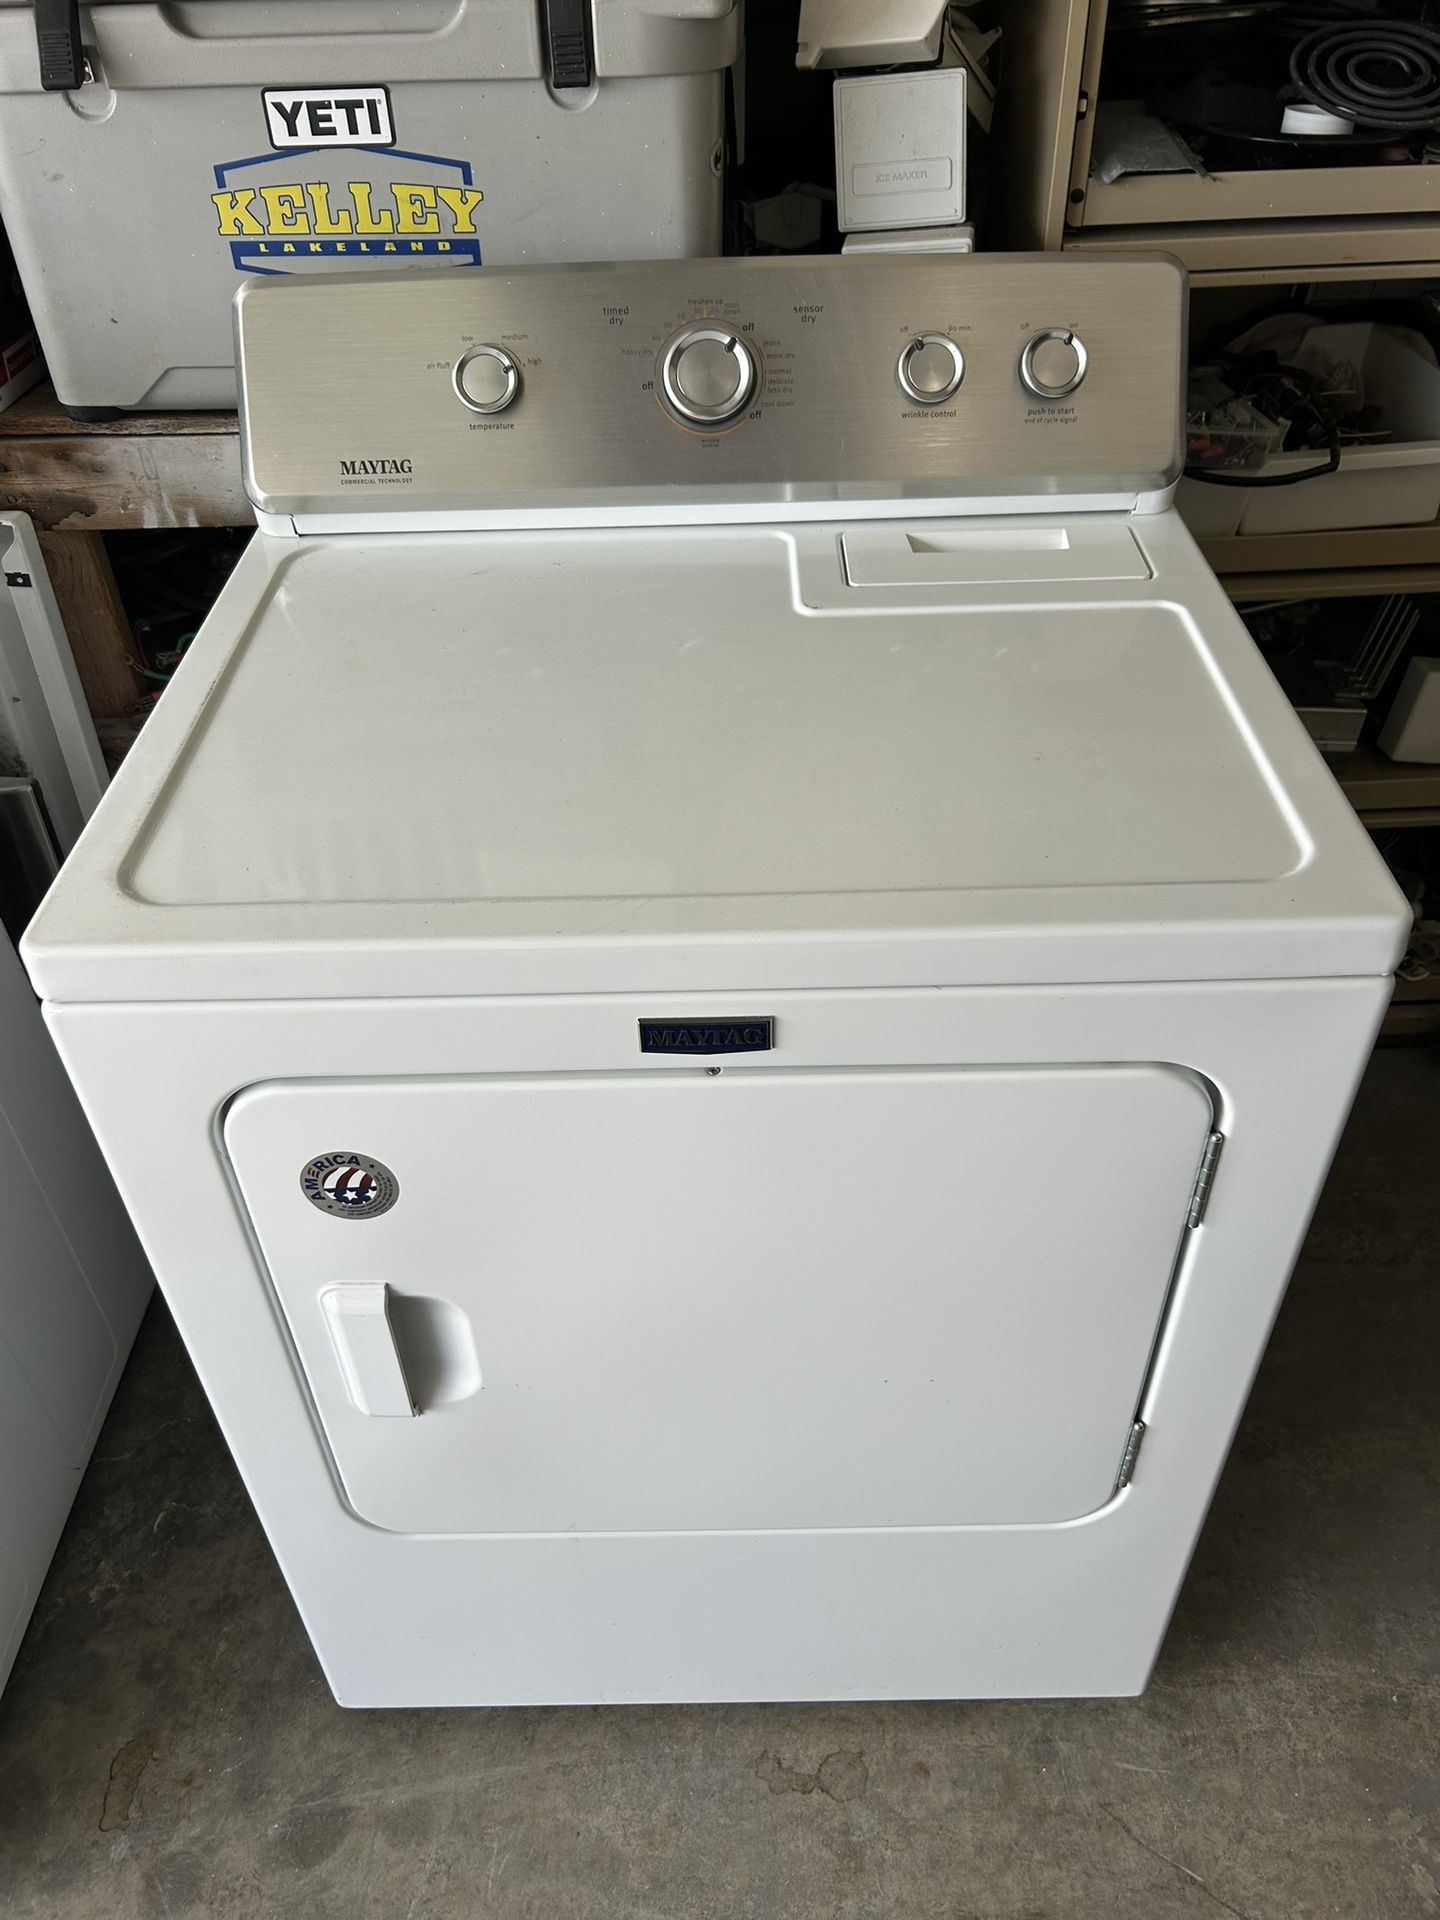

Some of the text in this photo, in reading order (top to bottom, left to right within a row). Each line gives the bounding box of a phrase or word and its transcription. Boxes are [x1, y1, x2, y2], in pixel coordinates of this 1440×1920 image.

[271, 98, 382, 137] YETI
[875, 173, 891, 184] ICE
[211, 182, 484, 236] KELLEY
[259, 241, 452, 253] LAKELAND
[603, 305, 630, 315] timed
[793, 305, 824, 313] sensor
[609, 316, 624, 326] dry
[801, 314, 816, 324] dry
[742, 322, 755, 332] off
[501, 333, 529, 341] medium
[426, 362, 436, 370] air
[527, 358, 542, 367] high
[641, 381, 654, 390] off
[750, 410, 762, 420] off
[901, 410, 957, 418] wrinkle control
[1027, 408, 1046, 417] push
[1057, 407, 1075, 415] start
[1060, 416, 1078, 425] signal
[469, 422, 515, 432] temperature
[340, 459, 413, 475] MAYTAG
[650, 1028, 764, 1047] MAYTAG
[304, 1154, 361, 1201] AMERICA
